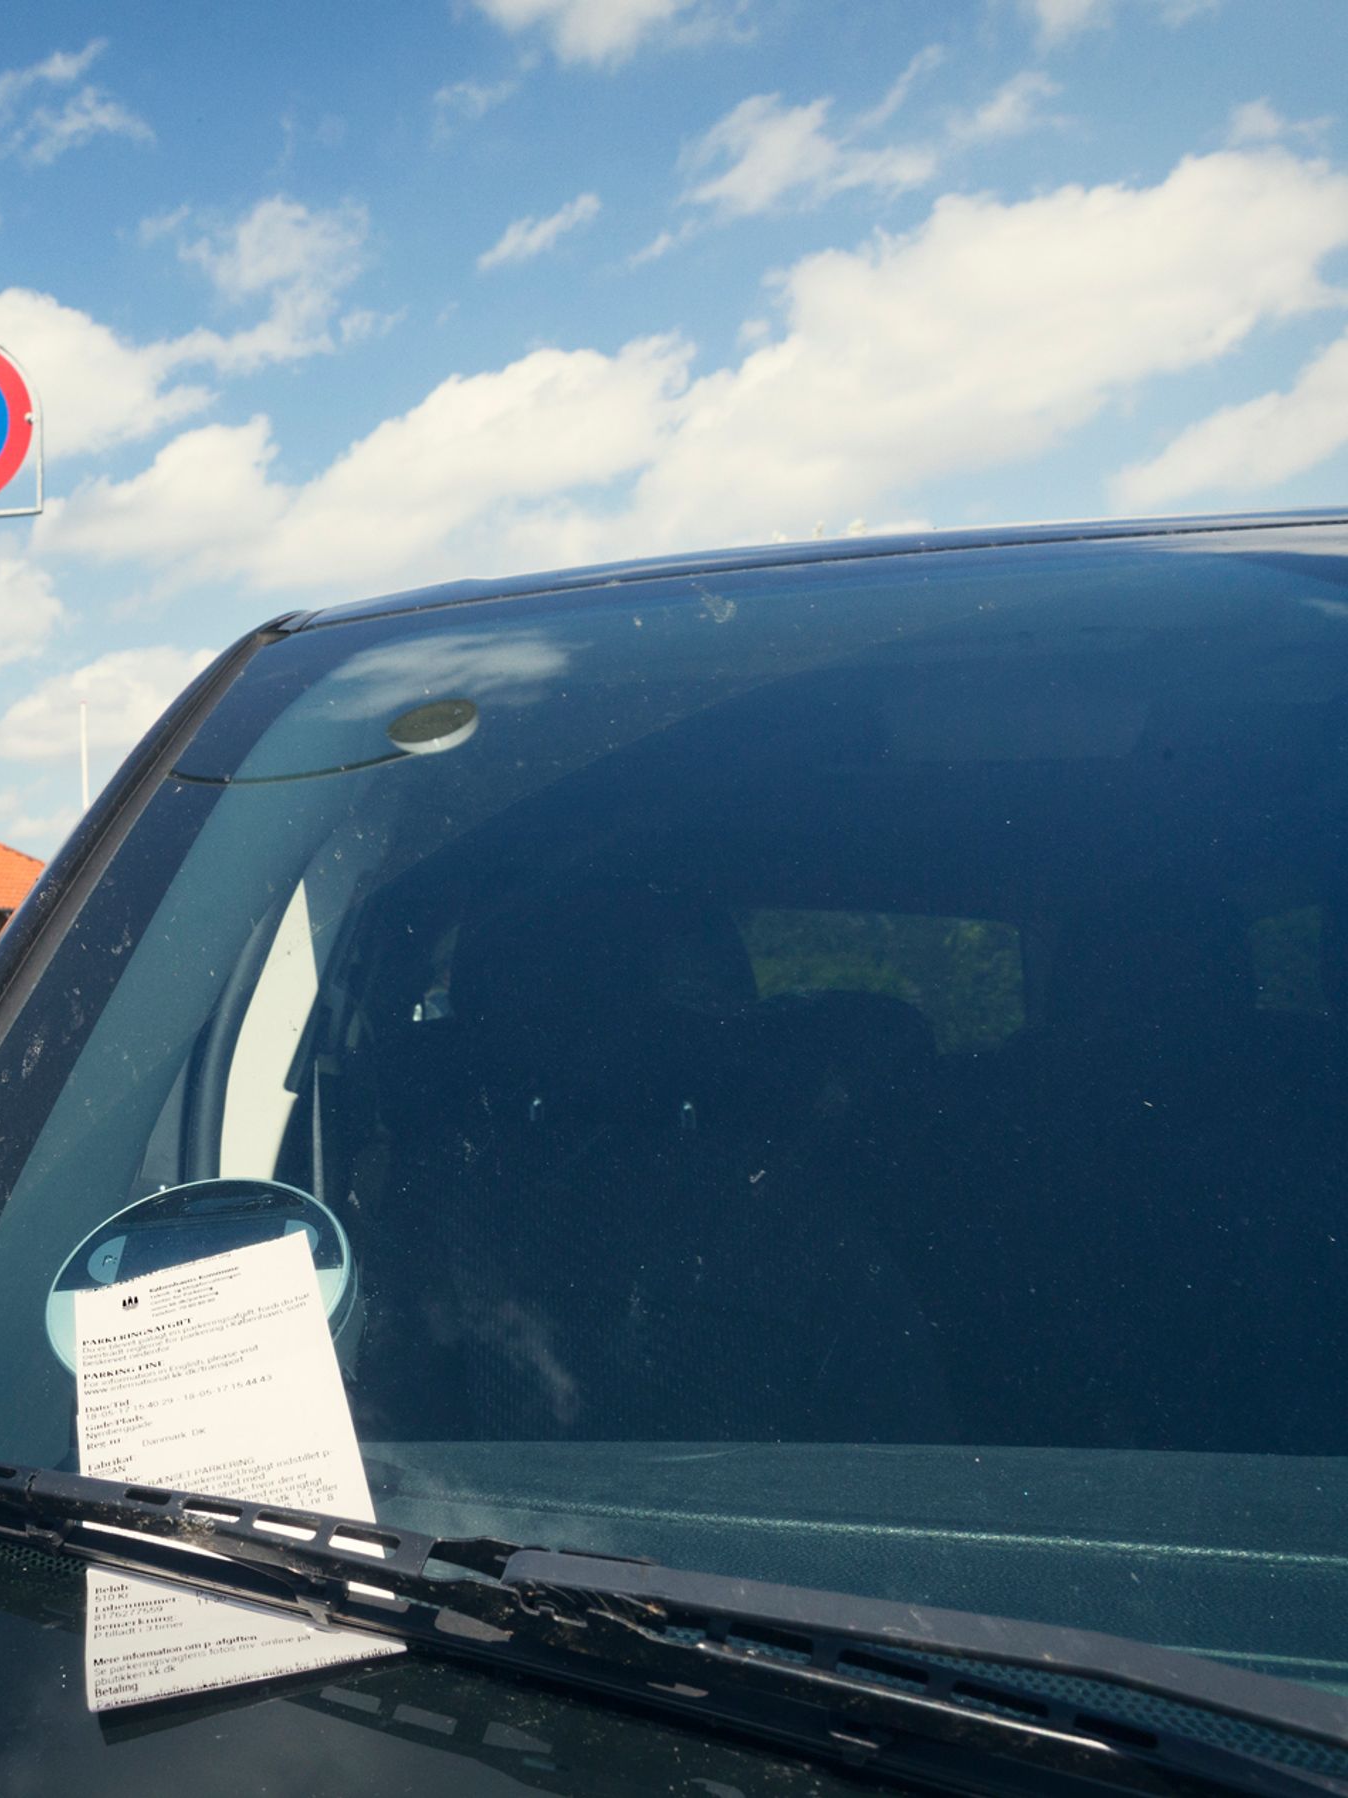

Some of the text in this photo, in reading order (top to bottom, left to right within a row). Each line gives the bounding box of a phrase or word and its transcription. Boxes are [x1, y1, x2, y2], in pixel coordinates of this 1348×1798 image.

[82, 1317, 193, 1346] PARKERINGSAFGIFT
[83, 1360, 163, 1381] PARKING FINE
[101, 1371, 155, 1386] information
[207, 1350, 237, 1365] please
[240, 1344, 259, 1355] visit
[95, 1593, 115, 1603] 510
[105, 1627, 136, 1639] tilladt
[154, 1620, 183, 1631] timer
[93, 1656, 120, 1667] Mere
[122, 1646, 182, 1661] information
[185, 1642, 202, 1651] om
[93, 1667, 107, 1677] Se
[109, 1650, 207, 1677] parkeringsvagtens
[209, 1645, 235, 1656] fotos
[261, 1636, 294, 1647] online
[297, 1633, 311, 1644] på
[95, 1665, 176, 1687] pbutikkenkkdk
[94, 1682, 139, 1699] Betaling
